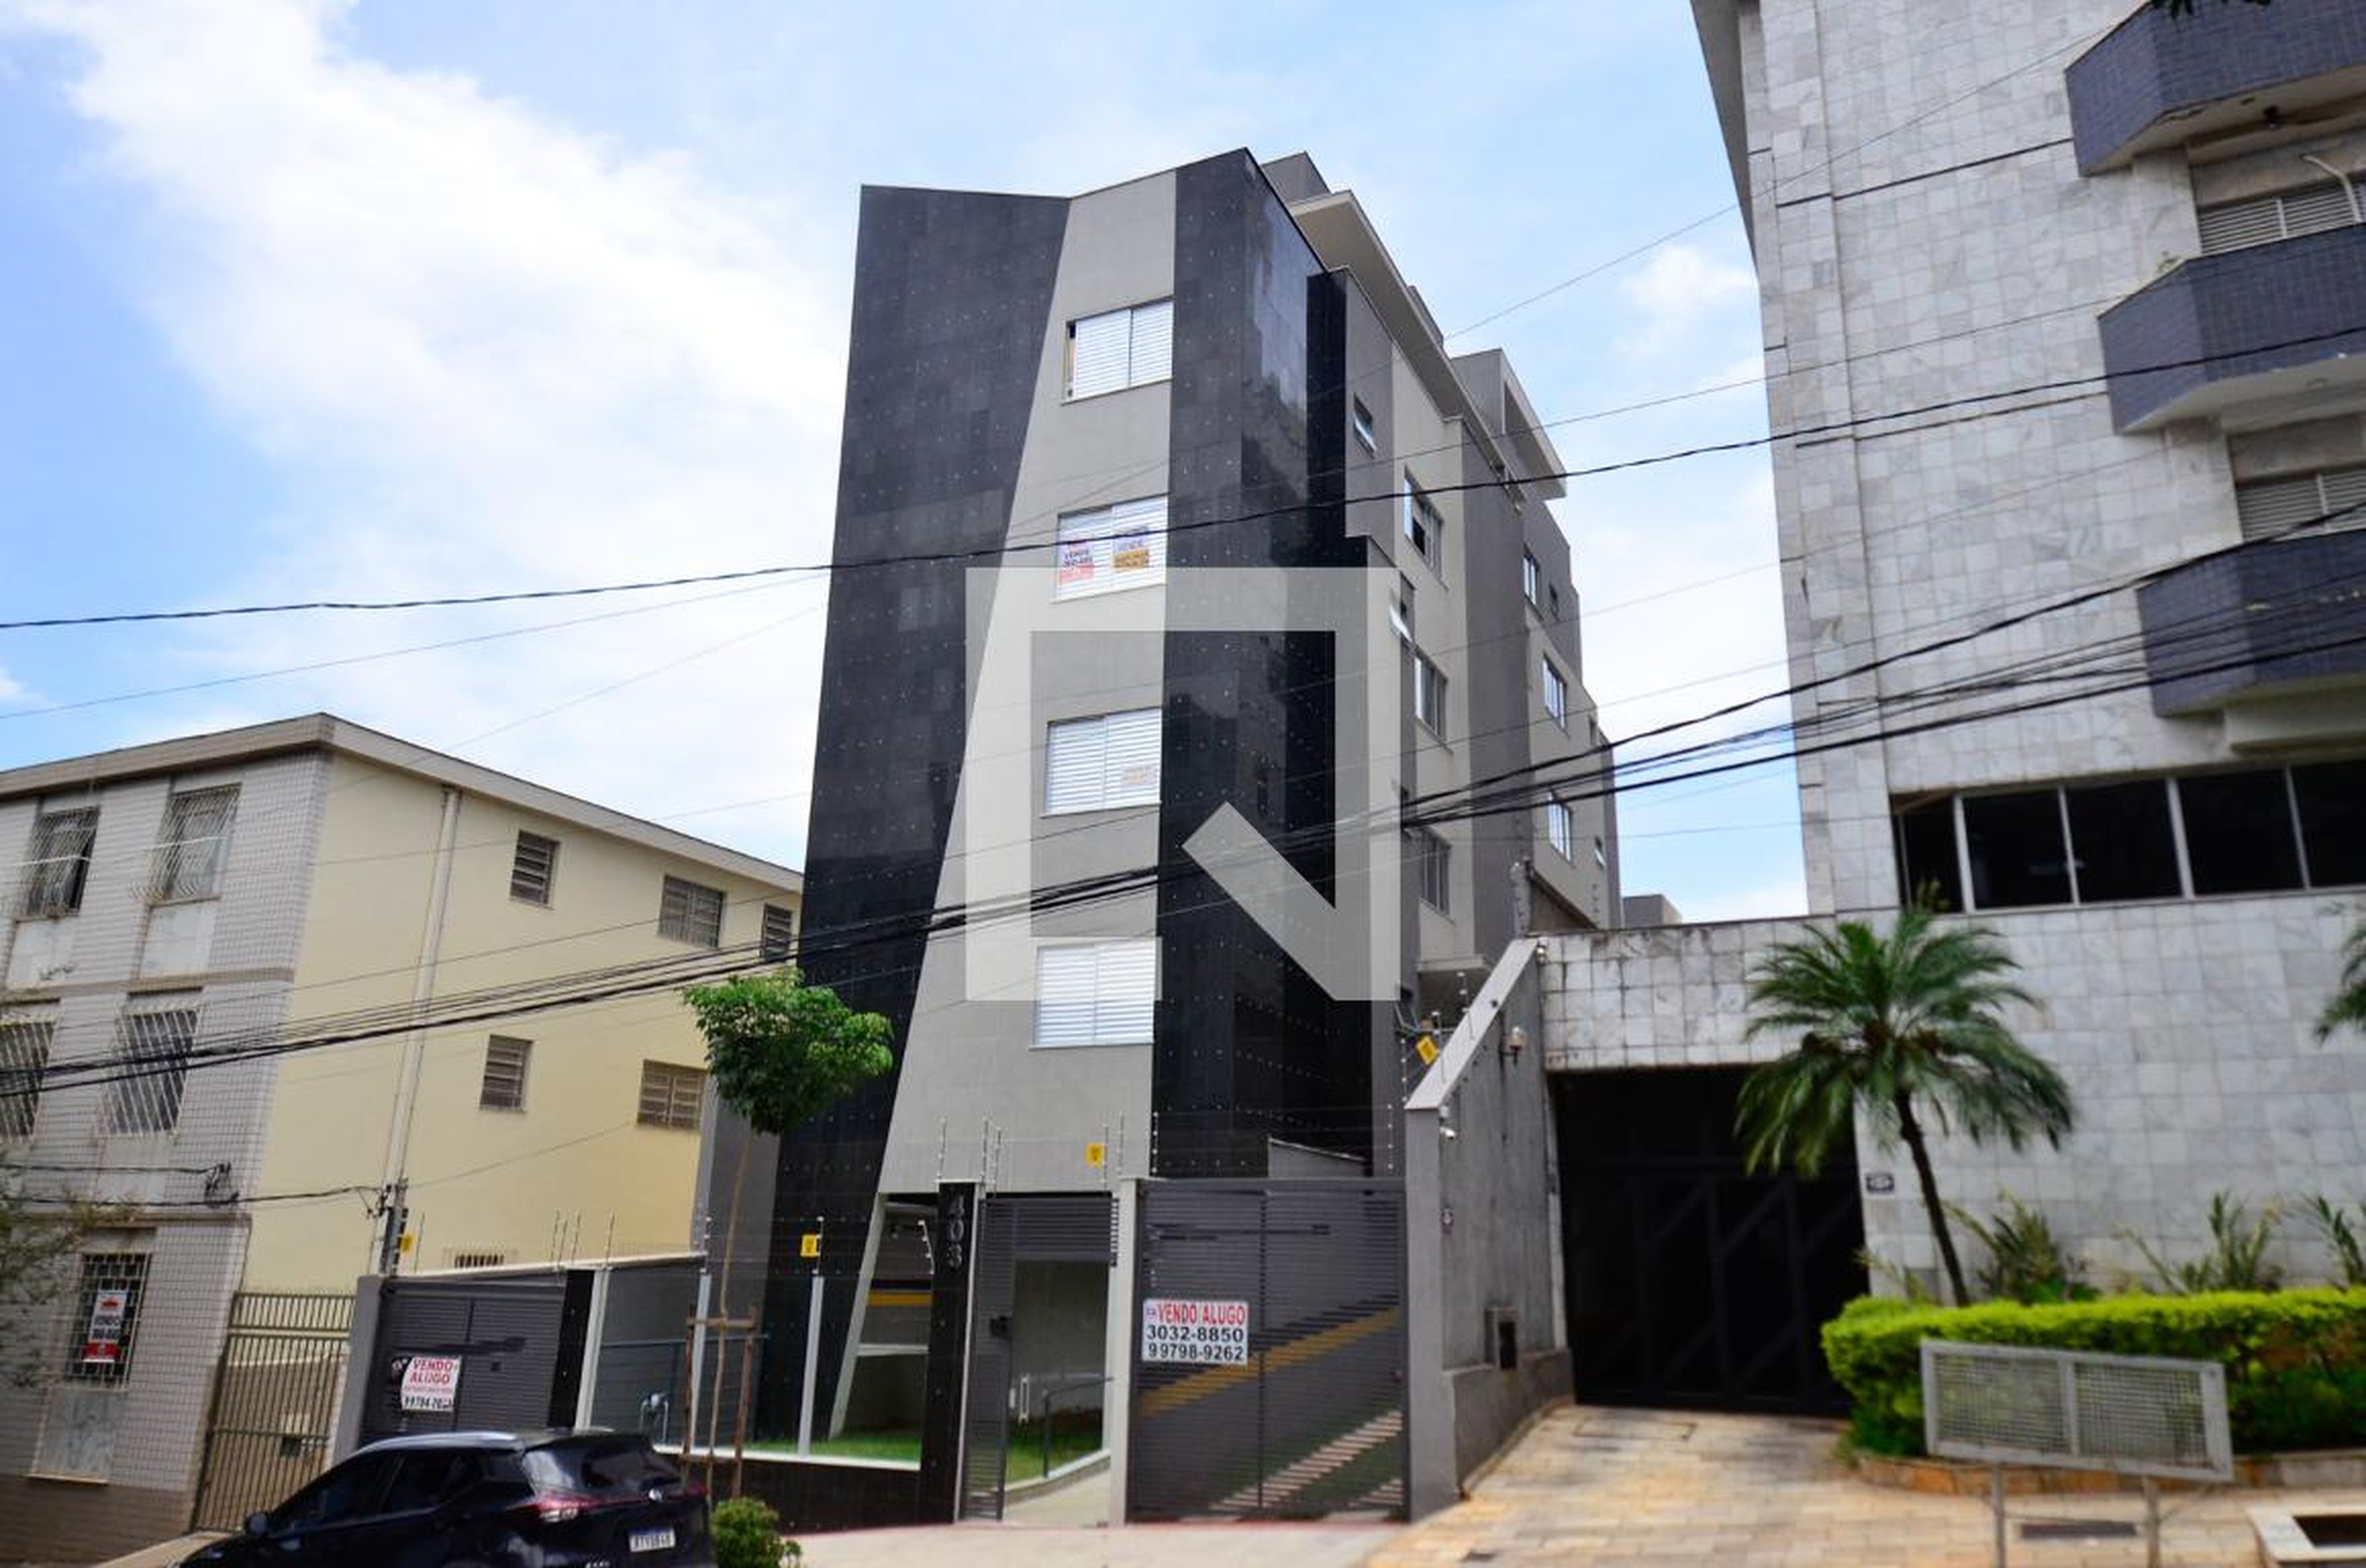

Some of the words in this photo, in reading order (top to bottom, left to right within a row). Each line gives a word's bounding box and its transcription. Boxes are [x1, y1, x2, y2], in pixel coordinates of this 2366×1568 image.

[1203, 1305, 1245, 1325] ALUGO
[1147, 1325, 1243, 1343] 3032-8850
[1148, 1343, 1244, 1360] 99798-9262
